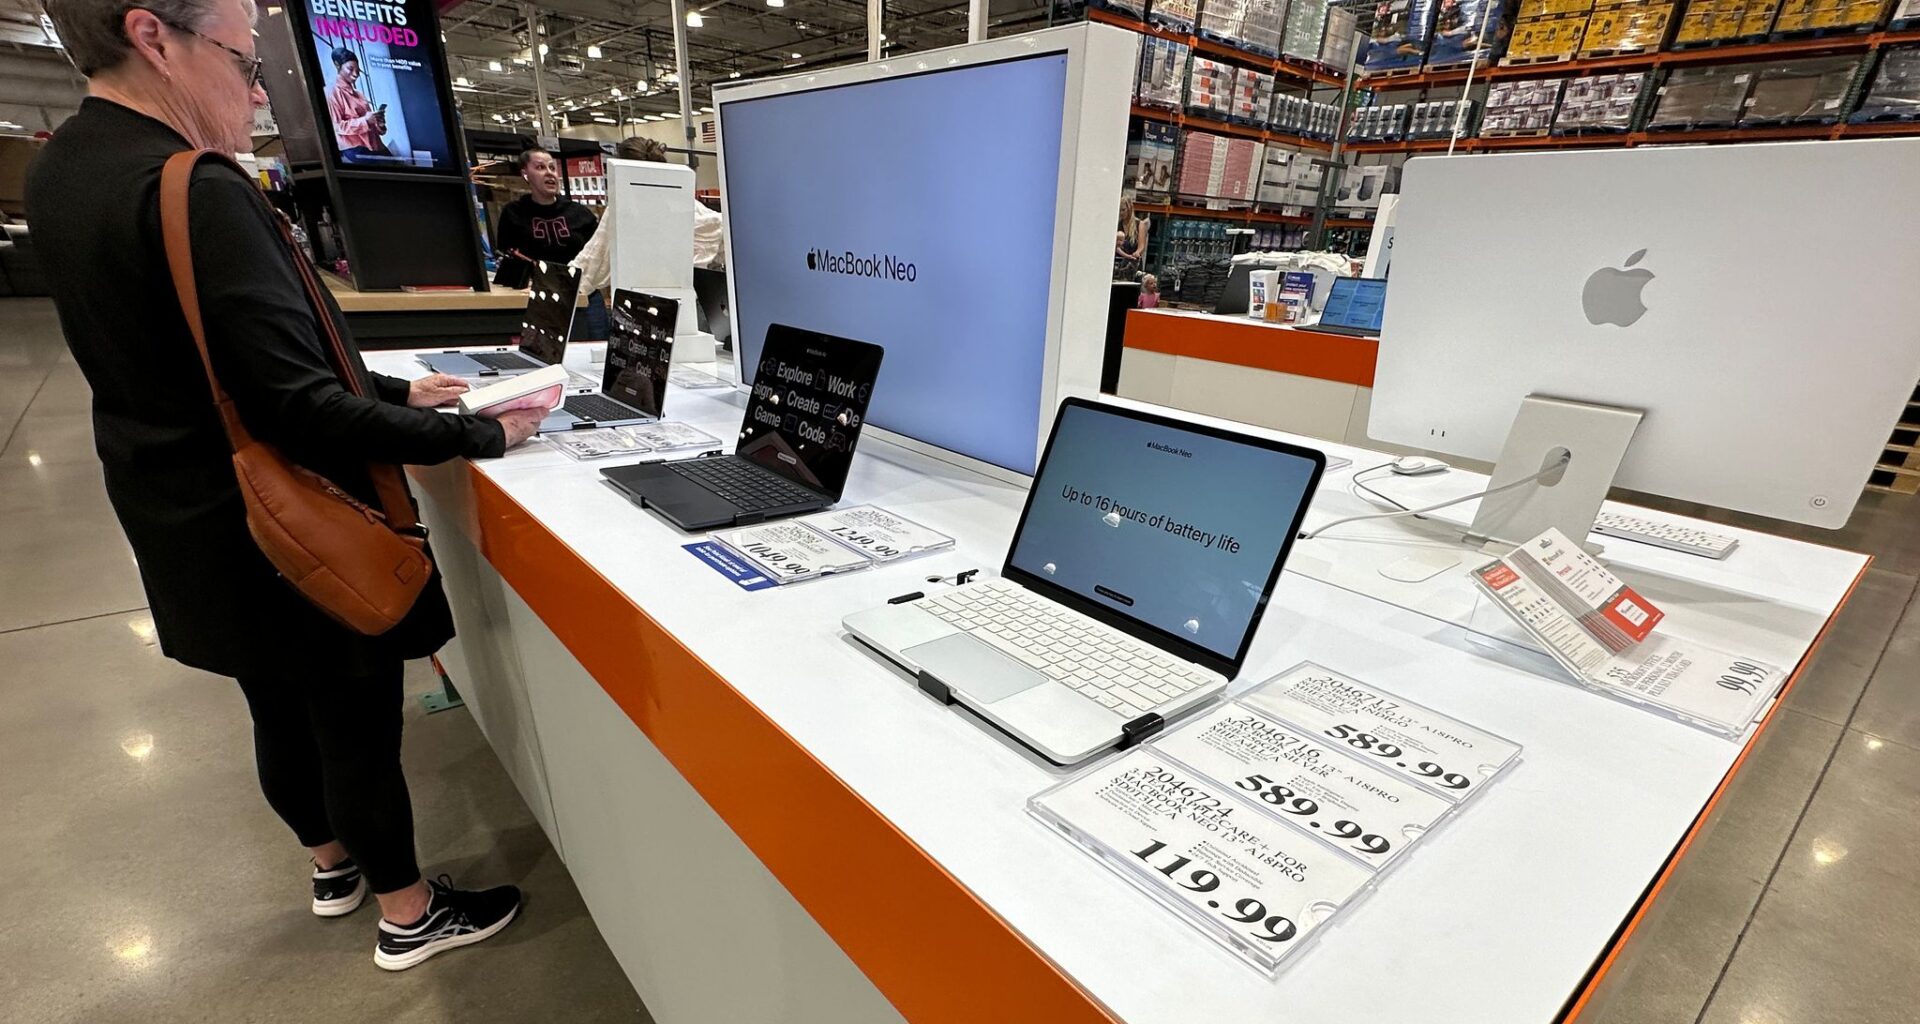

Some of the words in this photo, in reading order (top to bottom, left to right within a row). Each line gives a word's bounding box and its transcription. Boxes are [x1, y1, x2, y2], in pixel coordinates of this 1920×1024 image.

[312, 0, 408, 26] BENEFITS
[314, 15, 419, 47] INCLUDED
[578, 160, 597, 174] OPTICAL
[817, 248, 882, 279] MacBook
[884, 254, 917, 282] Neo
[753, 380, 773, 401] sign
[786, 390, 820, 415] Create
[776, 361, 813, 387] Explore
[827, 375, 857, 399] Work
[754, 405, 782, 428] Game
[798, 420, 827, 445] Code
[1151, 441, 1179, 456] MacBook
[1179, 448, 1193, 459] Neo
[1061, 484, 1078, 504] Up
[1080, 490, 1091, 506] to
[1096, 495, 1110, 512] 16
[1110, 500, 1147, 525] hours
[1148, 514, 1165, 529] of
[1165, 517, 1217, 550] battery
[1217, 534, 1241, 555] life
[742, 541, 811, 575] 1049.99
[829, 526, 900, 558] 1249.99
[1318, 675, 1401, 712] 2046717
[1716, 661, 1769, 697] 99.99
[1303, 676, 1366, 704] MACBOOK
[1366, 702, 1397, 717] NEO
[1419, 724, 1475, 749] A18PRO
[1359, 705, 1410, 728] INDIGO
[1237, 715, 1326, 758] 2046716
[1223, 716, 1289, 749] MACBOOK
[1287, 748, 1319, 764] NEO
[1343, 774, 1401, 804] A18PRO
[1278, 751, 1331, 778] SILVER
[1324, 723, 1471, 790] 589.99
[1143, 765, 1238, 819] 2046724
[1117, 772, 1189, 813] MACBOOK
[1186, 811, 1221, 832] NEO
[1219, 831, 1244, 847] 13"
[1243, 845, 1307, 884] A18PRO
[1127, 767, 1177, 796] 3-YEAR
[1175, 795, 1274, 851] APPLECARE+
[1273, 850, 1310, 873] FOR
[1235, 774, 1391, 854] 589.99
[1130, 838, 1297, 943] 119.99
